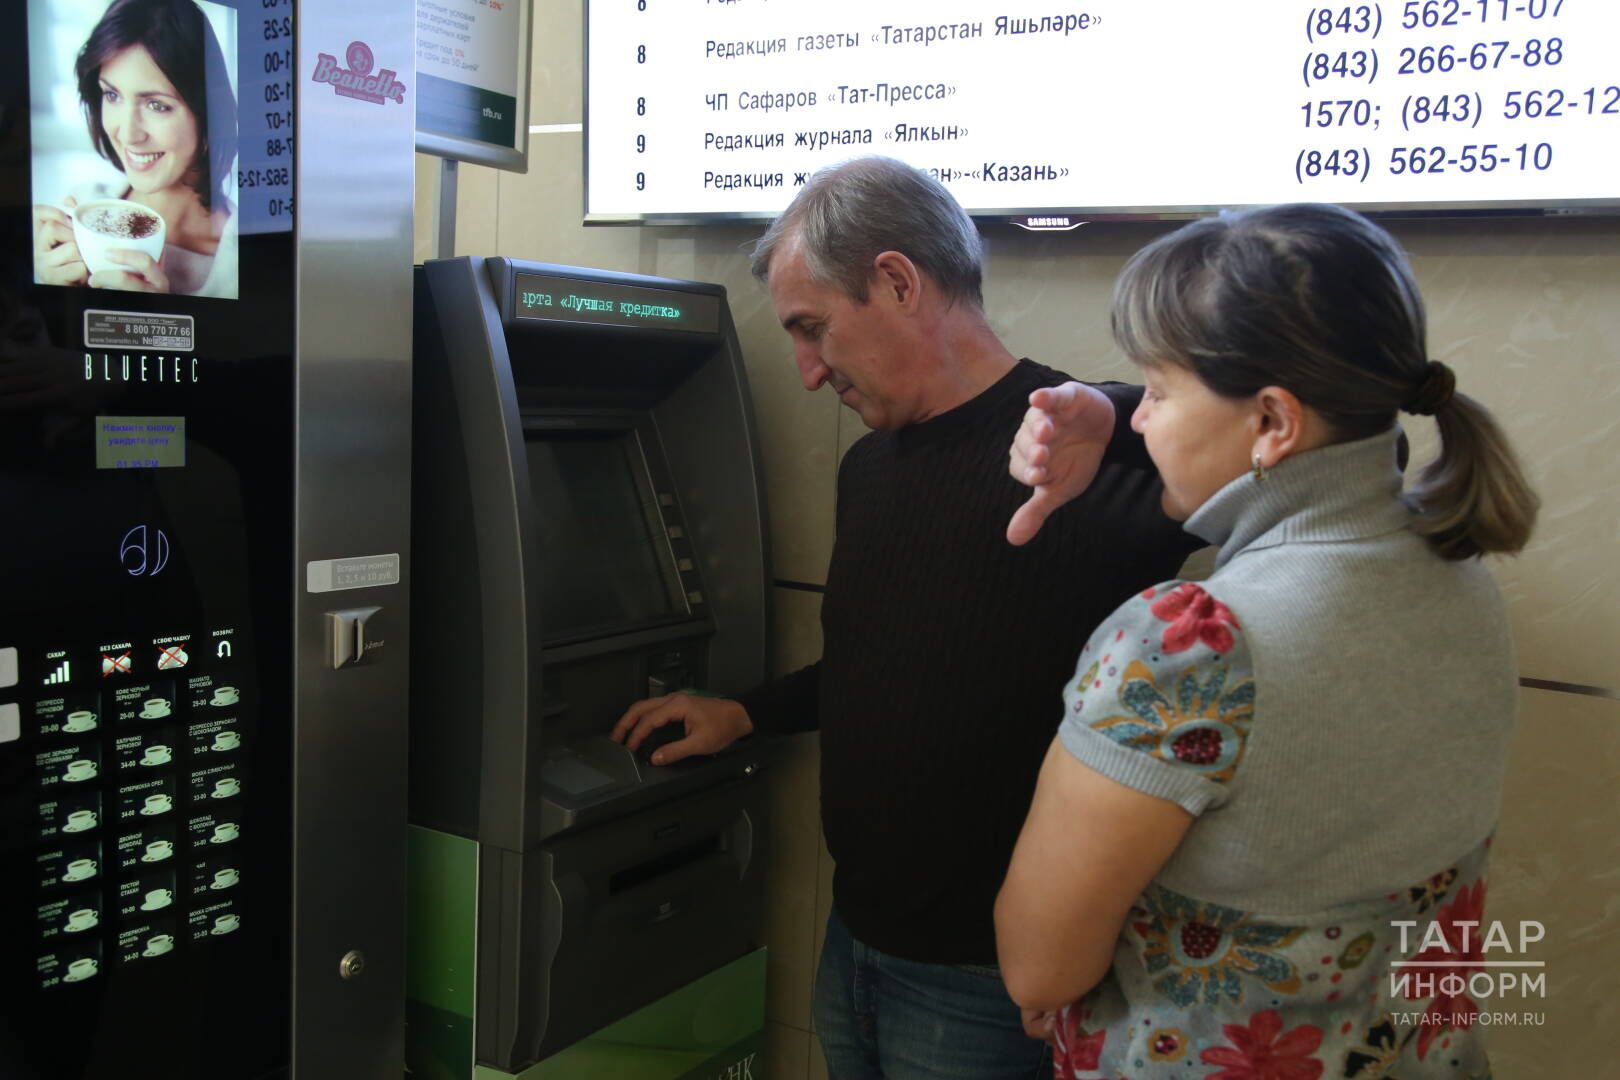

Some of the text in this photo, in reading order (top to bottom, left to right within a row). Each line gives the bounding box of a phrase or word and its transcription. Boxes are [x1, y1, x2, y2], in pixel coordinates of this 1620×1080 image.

[1305, 0, 1564, 43] (843) 562-11-07
[706, 13, 1102, 58] Редакция газеты «Татарстан Яшьләре»
[637, 45, 646, 64] 8
[1302, 38, 1563, 87] (843) 266-67-88
[637, 97, 646, 116] 8
[705, 83, 956, 113] ЧП Сафаров «Тат-Пресса»
[1301, 86, 1620, 131] 1570; (843) 562-12
[636, 135, 646, 153] 9
[705, 124, 968, 152] Редакция журнала «Ялкын»
[704, 171, 784, 190] Редакция
[922, 163, 1069, 182] ан»-«Казань»
[1295, 142, 1553, 184] (843) 562-55-10
[636, 172, 646, 190] 9
[1028, 217, 1070, 226] SAMSUNG
[560, 295, 613, 313] «Лучшая
[619, 301, 680, 319] кредитка»
[133, 325, 149, 335] 800
[151, 326, 166, 335] 770
[168, 326, 178, 336] 77
[180, 327, 191, 336] 66
[85, 353, 198, 382] BLUETEC
[47, 651, 66, 659] САХАР
